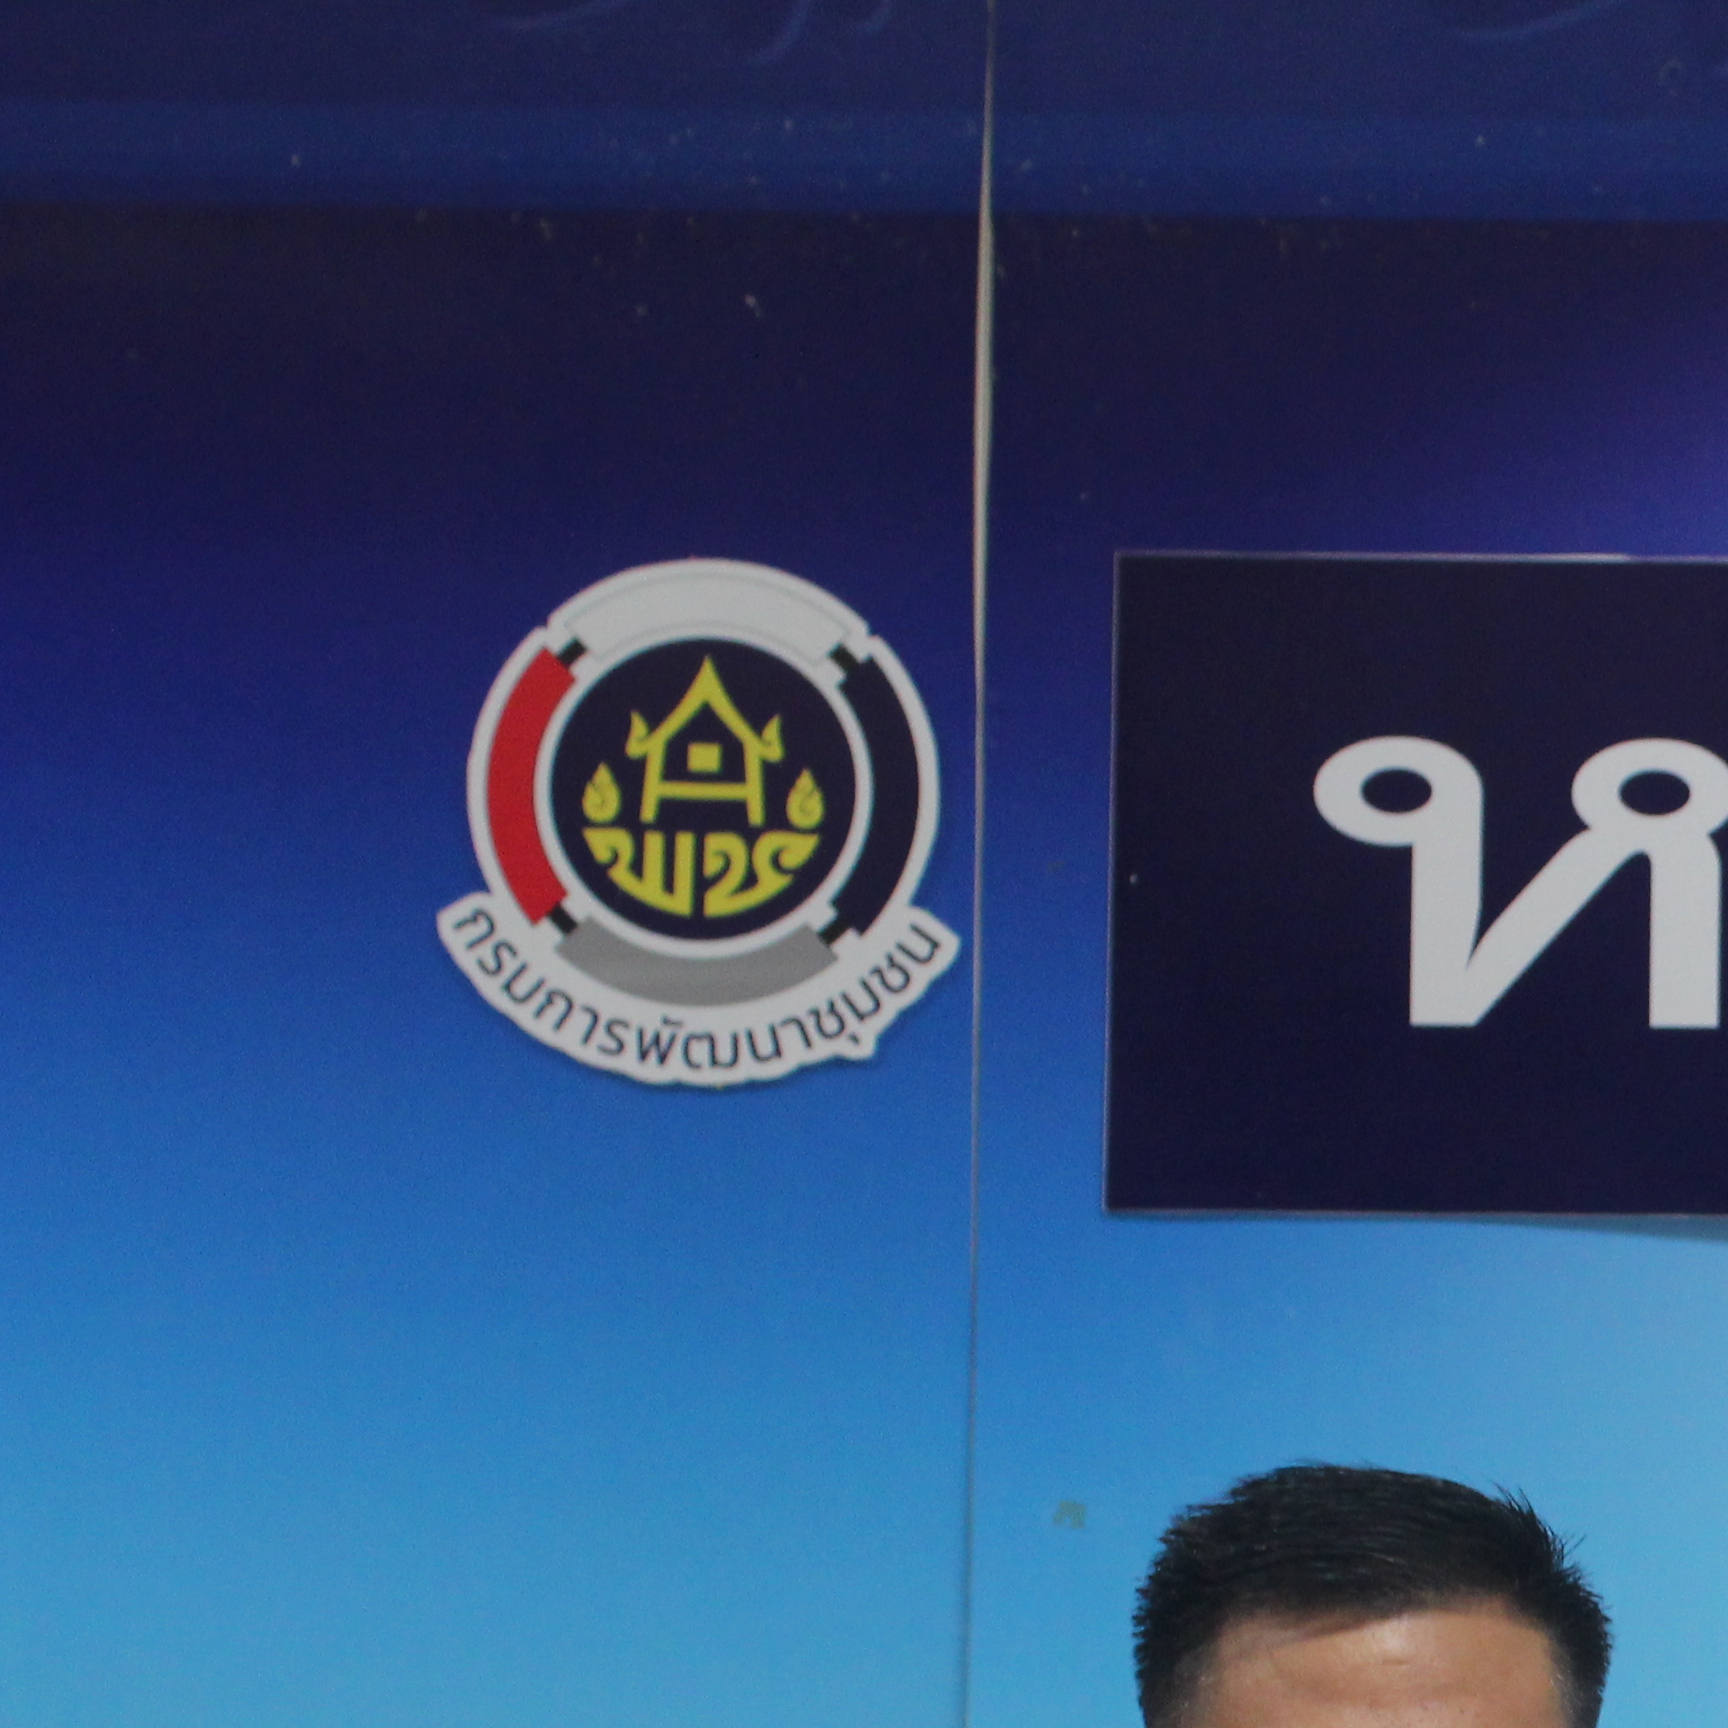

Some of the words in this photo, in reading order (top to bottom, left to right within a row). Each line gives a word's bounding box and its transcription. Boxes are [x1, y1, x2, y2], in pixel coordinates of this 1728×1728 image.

[453, 908, 941, 1069] กรมการพัฒนาชุมชน
